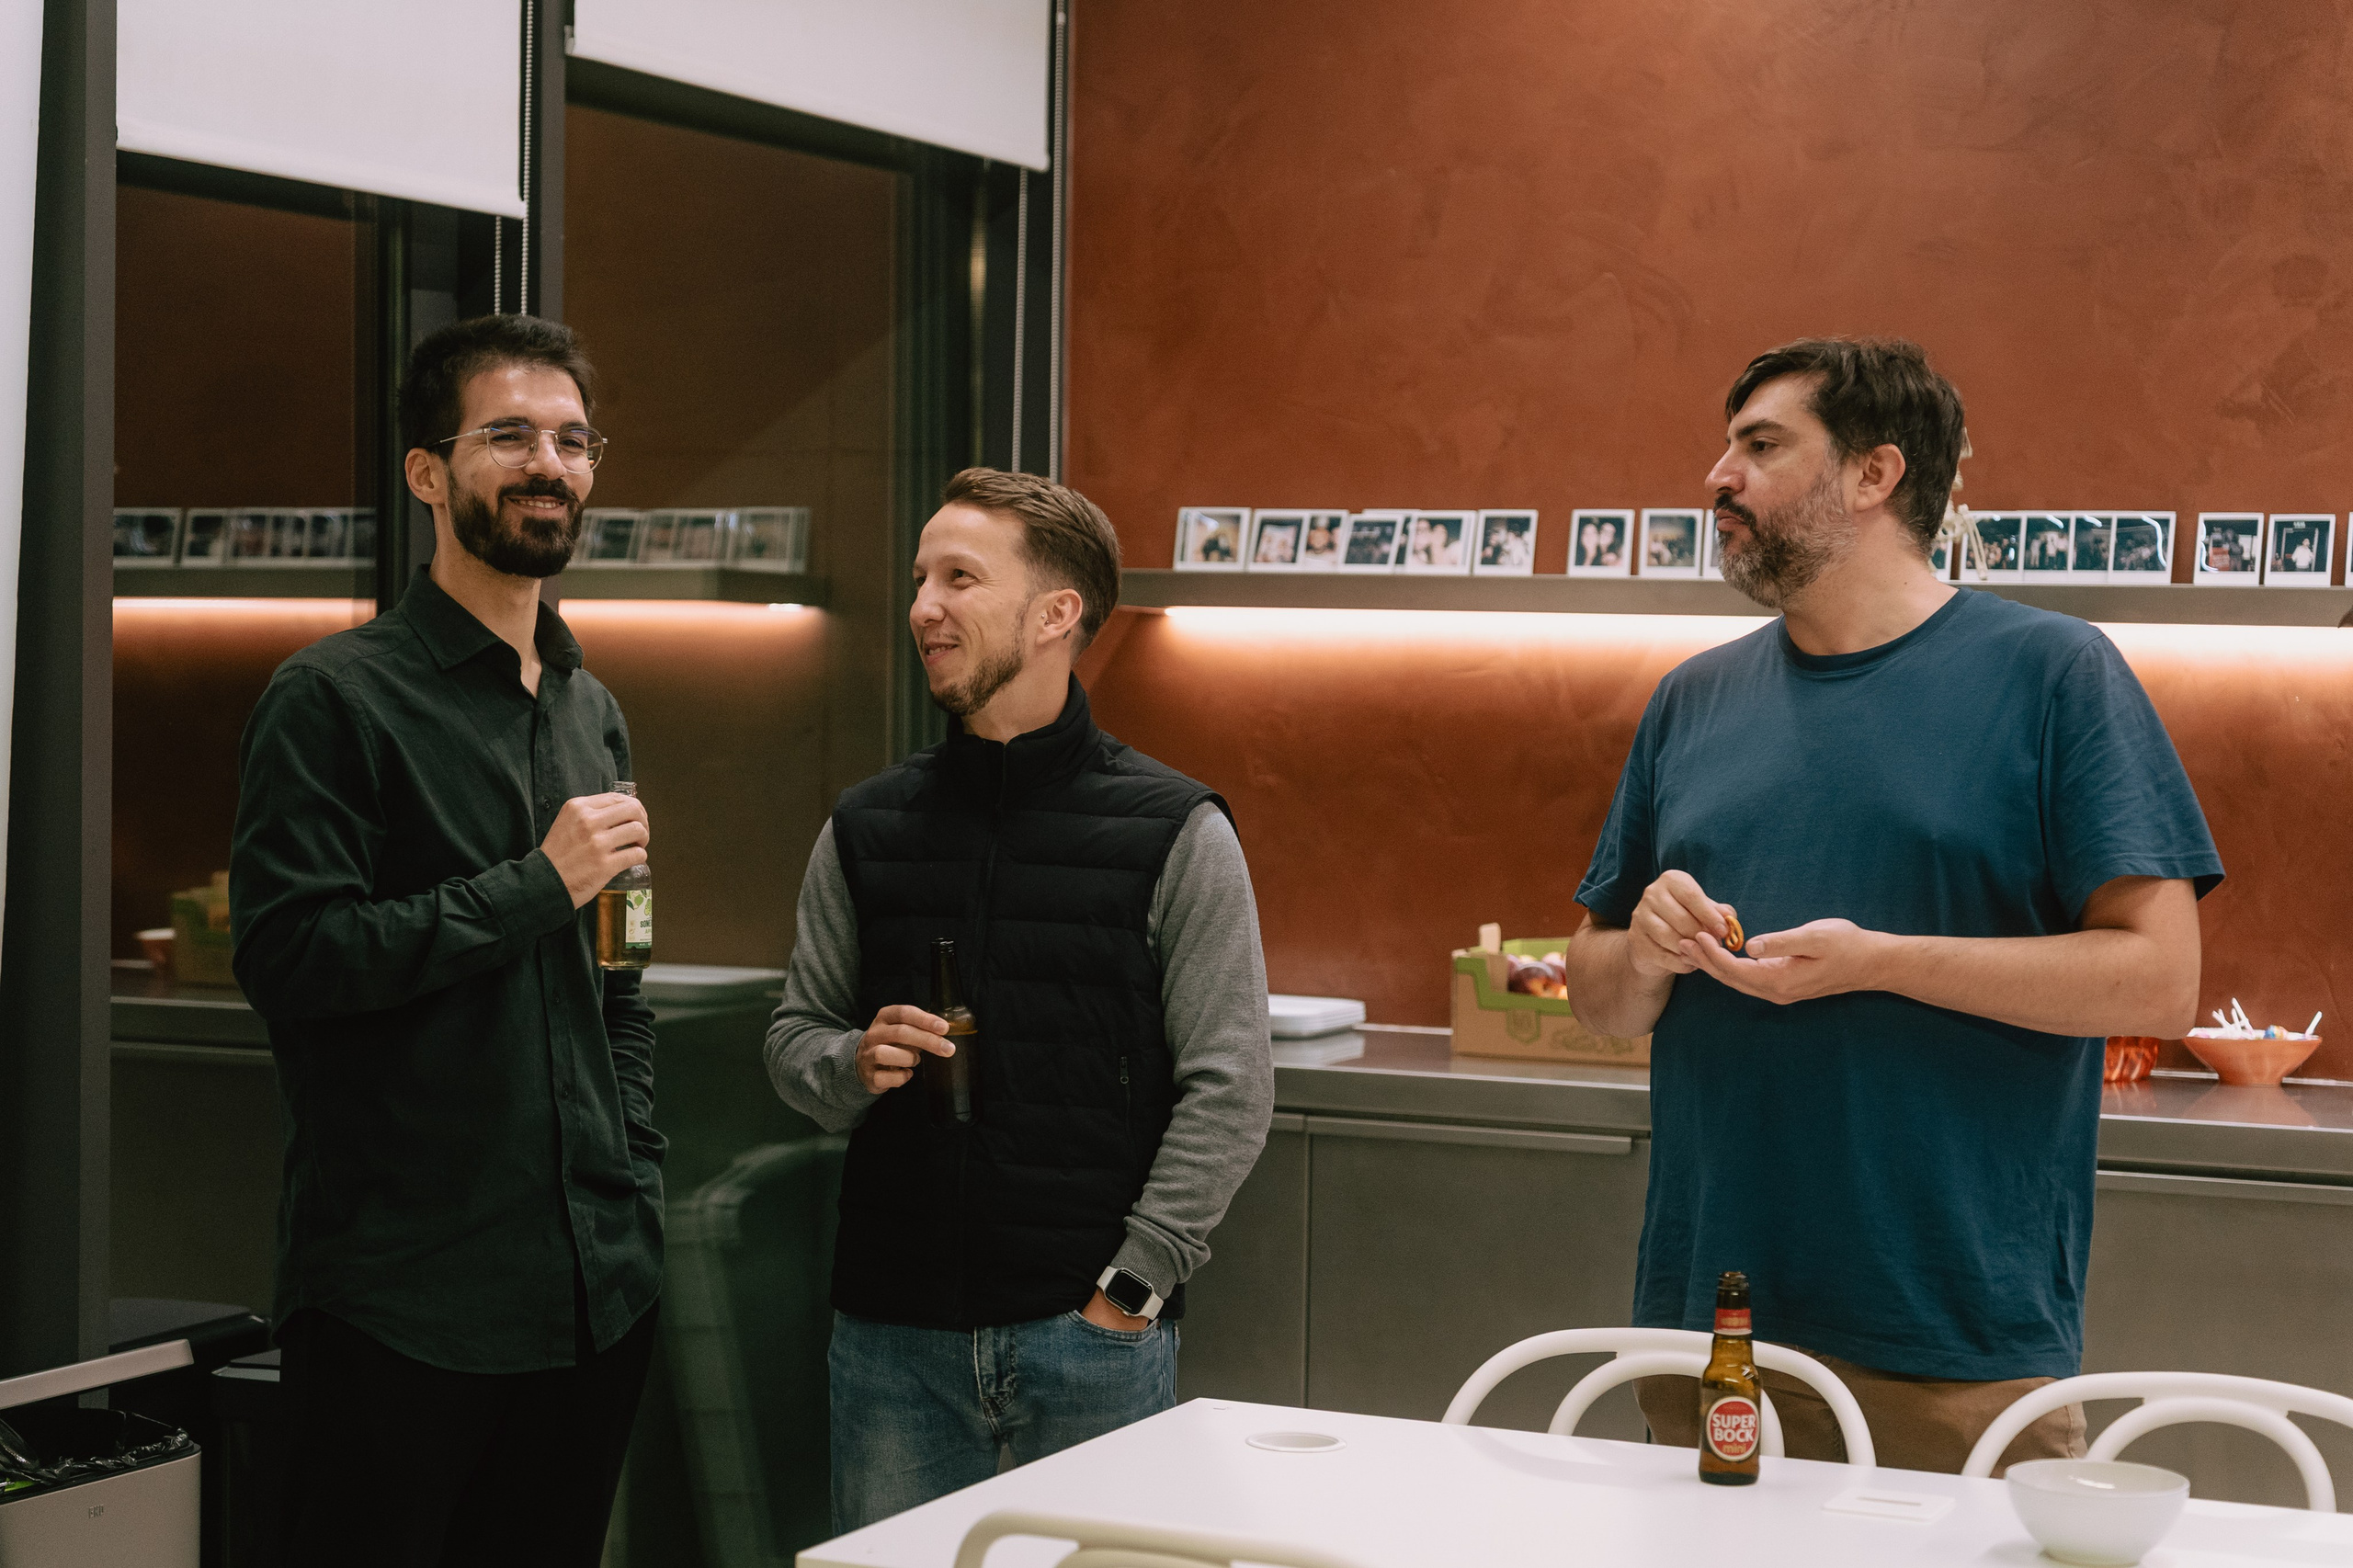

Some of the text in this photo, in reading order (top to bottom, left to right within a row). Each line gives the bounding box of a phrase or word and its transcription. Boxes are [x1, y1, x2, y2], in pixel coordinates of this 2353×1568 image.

[1712, 1414, 1756, 1428] SUPER
[1714, 1427, 1755, 1442] BOCK
[1722, 1442, 1746, 1453] mini
